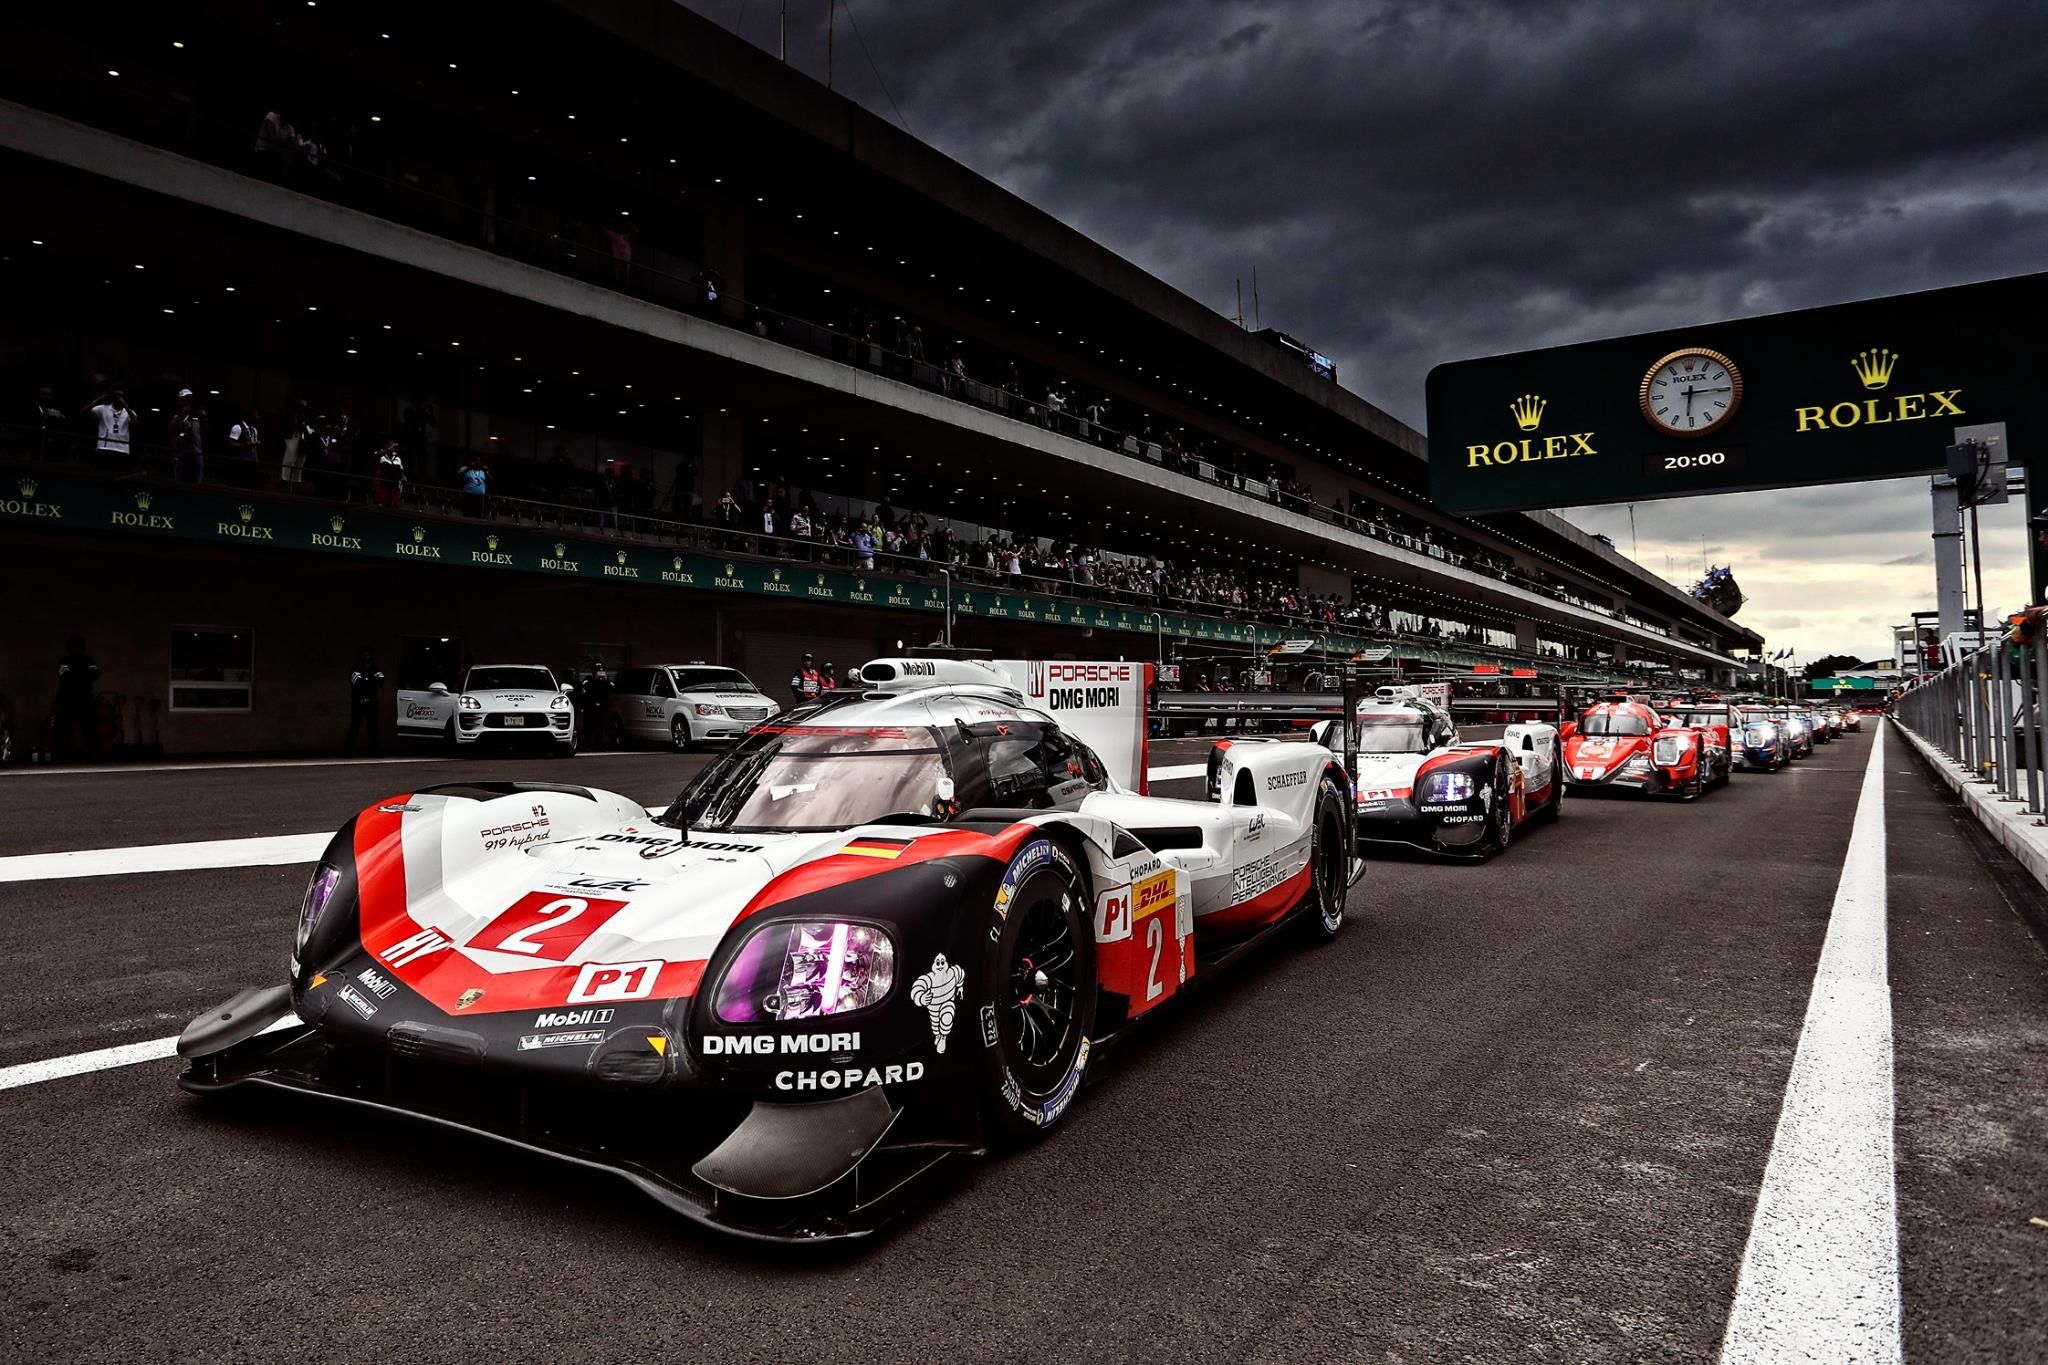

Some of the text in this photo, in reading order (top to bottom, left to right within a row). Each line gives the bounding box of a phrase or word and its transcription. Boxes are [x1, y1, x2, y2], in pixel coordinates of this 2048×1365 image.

[1673, 374, 1706, 384] ROLEX
[1795, 390, 1965, 433] ROLEX
[1466, 432, 1597, 468] ROLEX
[1664, 453, 1725, 469] 20:00
[112, 510, 174, 530] ROLEX
[218, 522, 273, 540] ROLEX
[312, 533, 362, 550] ROLEX
[396, 543, 440, 558] ROLEX
[472, 552, 513, 566] ROLEX
[540, 558, 578, 572] ROLEX
[604, 565, 638, 578] ROLEX
[662, 571, 693, 584] ROLEX
[714, 578, 744, 590] ROLEX
[763, 582, 790, 593] ROLEX
[808, 586, 833, 597] ROLEX
[850, 590, 873, 602] ROLEX
[888, 595, 911, 606] ROLEX
[924, 599, 945, 610] ROLEX
[990, 608, 1007, 616] ROLEX
[900, 662, 927, 676] Mobil
[1049, 665, 1130, 682] PORSCHE
[1050, 687, 1120, 710] DMG MORI
[1268, 770, 1307, 791] SCHAEFFLER
[1368, 790, 1387, 799] P1
[532, 804, 547, 818] #2
[1444, 815, 1484, 824] CHOPARD
[480, 818, 550, 838] PORSCHE
[485, 829, 550, 851] 919 hybrid
[598, 834, 765, 853] DMG MORI
[1012, 845, 1048, 883] MICHELIN
[1130, 858, 1161, 880] CHOPARD
[1233, 855, 1270, 880] PORSCHE
[568, 878, 650, 892] WEC
[1232, 862, 1279, 892] INTELLIGENT
[1139, 880, 1172, 911] DHL
[1232, 870, 1288, 904] PERFORMANCE
[1103, 894, 1128, 936] P1
[496, 898, 588, 954] 2
[380, 928, 451, 968] HY
[1147, 918, 1162, 1001] 2
[357, 968, 388, 996] Mobil
[584, 966, 650, 996] P1
[534, 1010, 593, 1028] Mobil
[544, 1032, 602, 1044] MICHELIN
[702, 1032, 860, 1055] DMG MORI
[774, 1062, 924, 1090] CHOPARD
